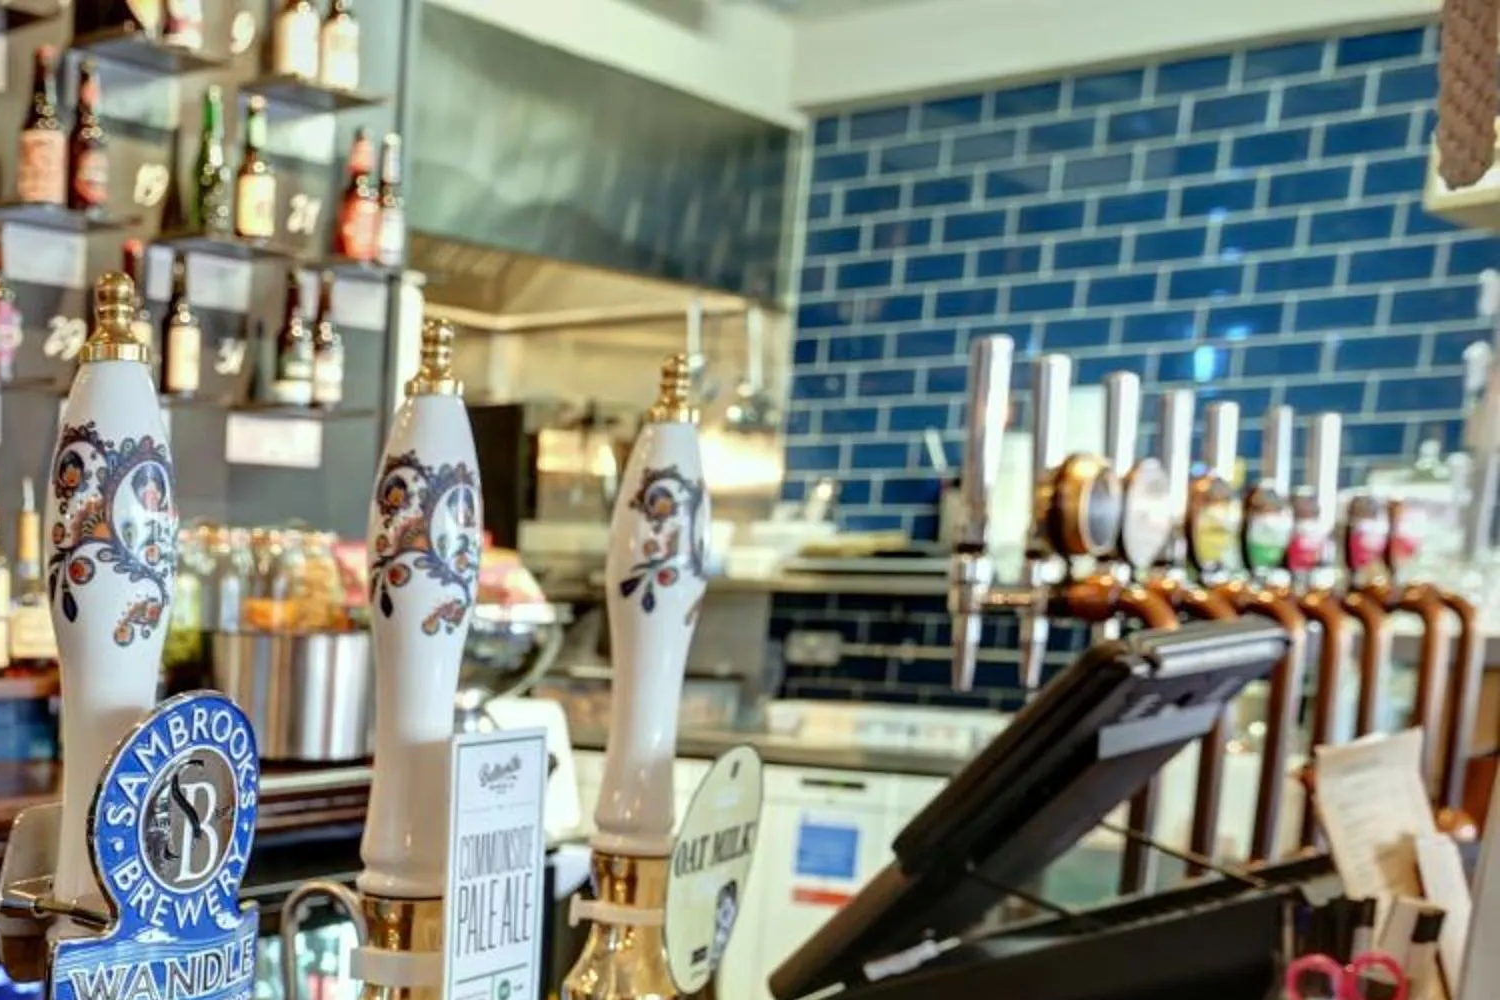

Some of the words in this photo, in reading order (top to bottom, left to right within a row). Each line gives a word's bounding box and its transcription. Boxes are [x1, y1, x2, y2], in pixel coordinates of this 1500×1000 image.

[105, 706, 256, 828] SAMBROOK'S
[112, 839, 245, 929] BREWERY
[674, 834, 710, 877] OAT
[456, 879, 498, 957] PALE
[500, 872, 533, 946] ALE
